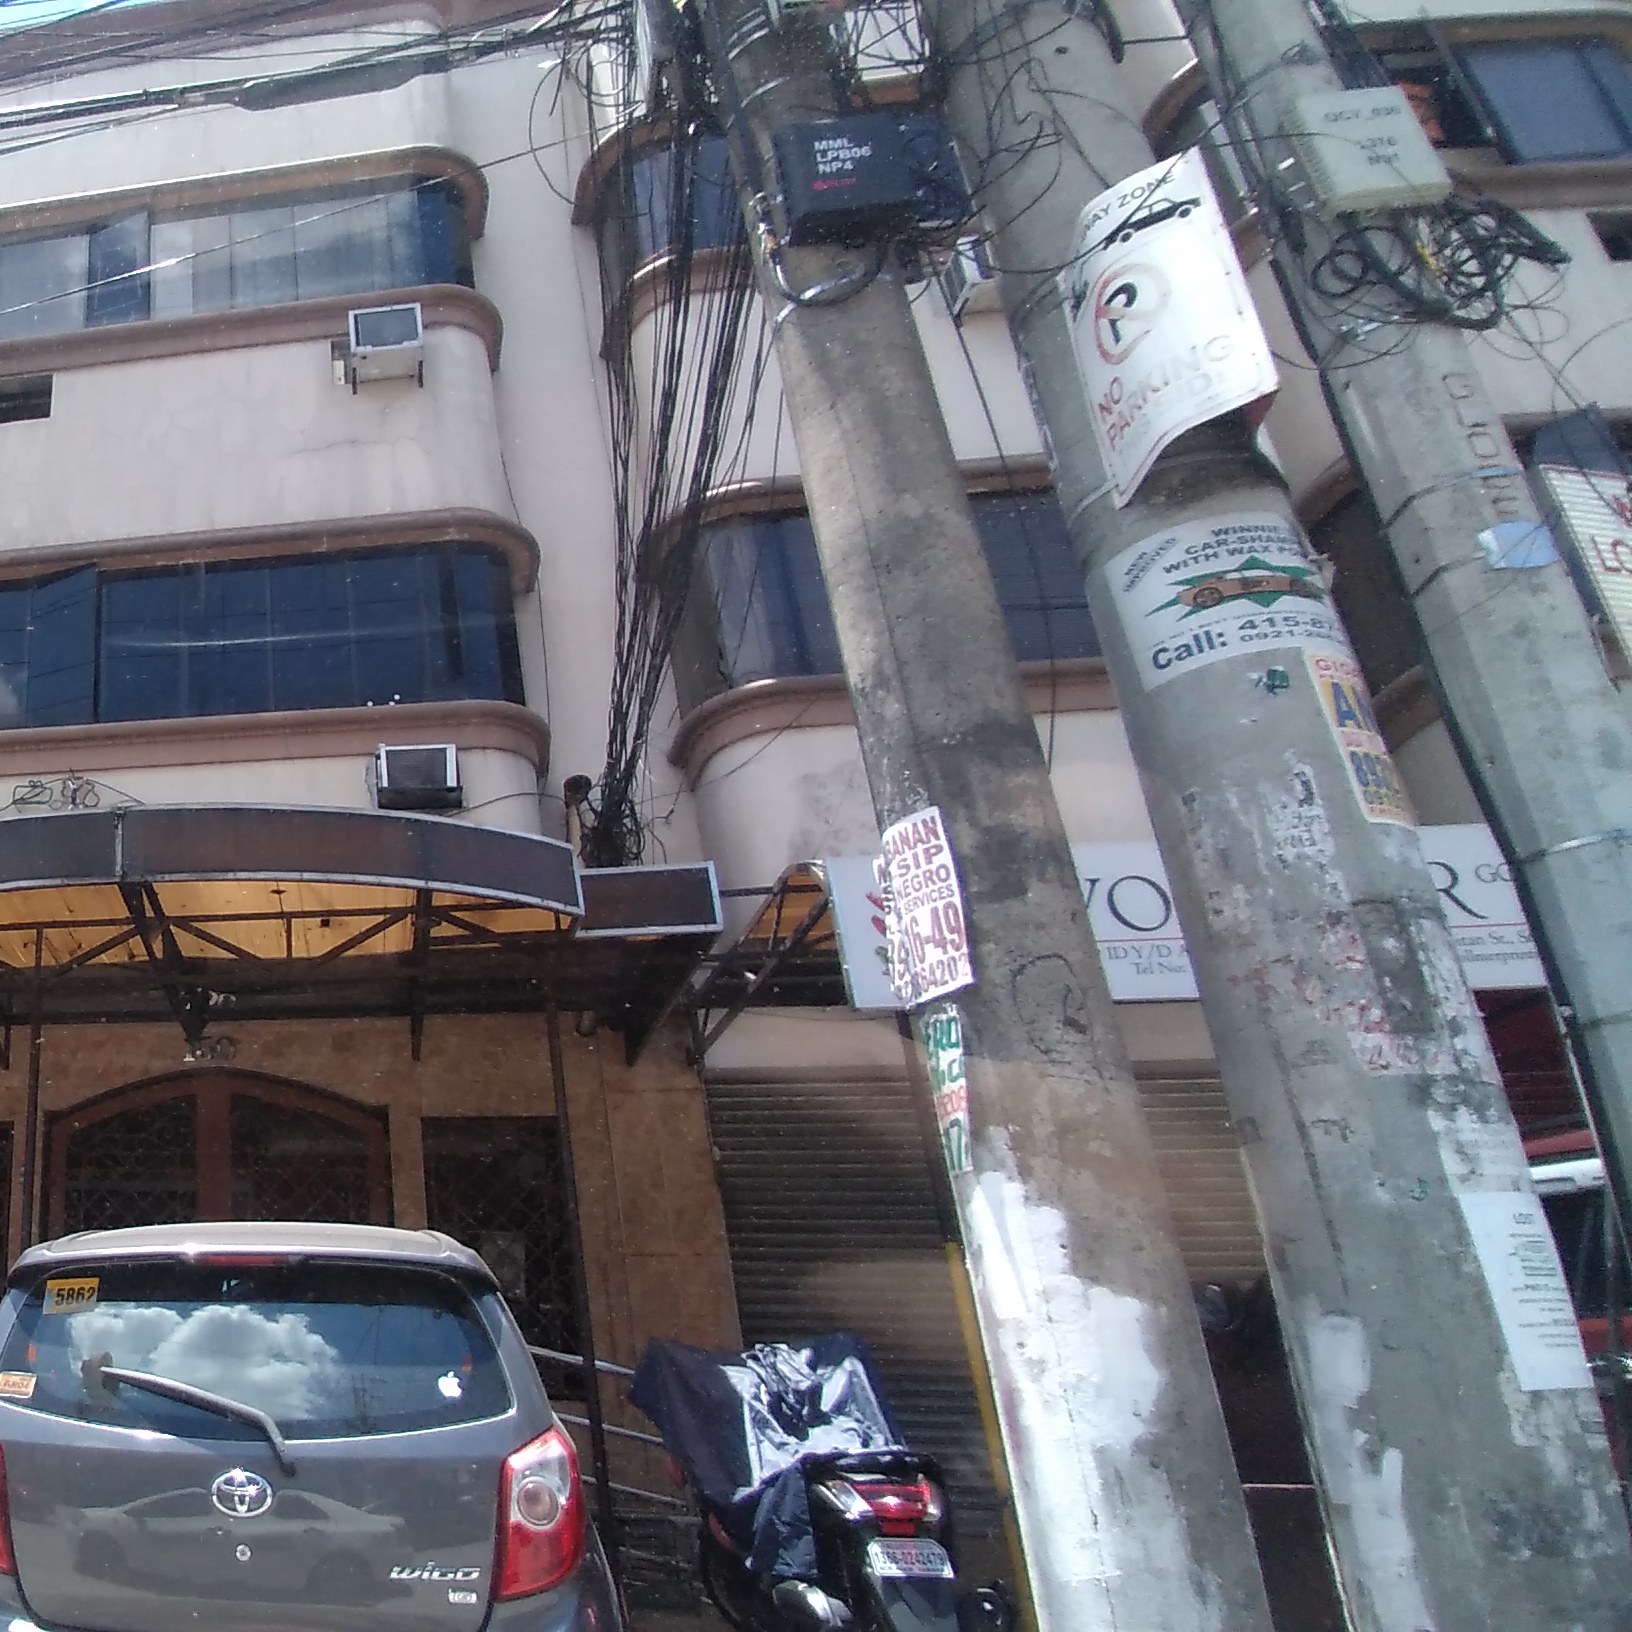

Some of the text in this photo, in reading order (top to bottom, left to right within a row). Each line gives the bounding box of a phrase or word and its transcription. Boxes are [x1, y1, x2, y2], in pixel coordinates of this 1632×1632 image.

[814, 137, 854, 151] MML
[818, 160, 855, 174] NP4
[1117, 170, 1176, 209] ZONE
[1098, 376, 1124, 424] NO
[1106, 334, 1234, 451] PARKING
[1162, 552, 1220, 575] WITH
[1225, 545, 1274, 556] WAX
[1152, 629, 1229, 672] Call:
[896, 844, 944, 878] SIP
[896, 863, 951, 902] NEGRO
[904, 883, 955, 915] SERVICES
[1131, 962, 1154, 975] Tel
[55, 1286, 97, 1306] 5862
